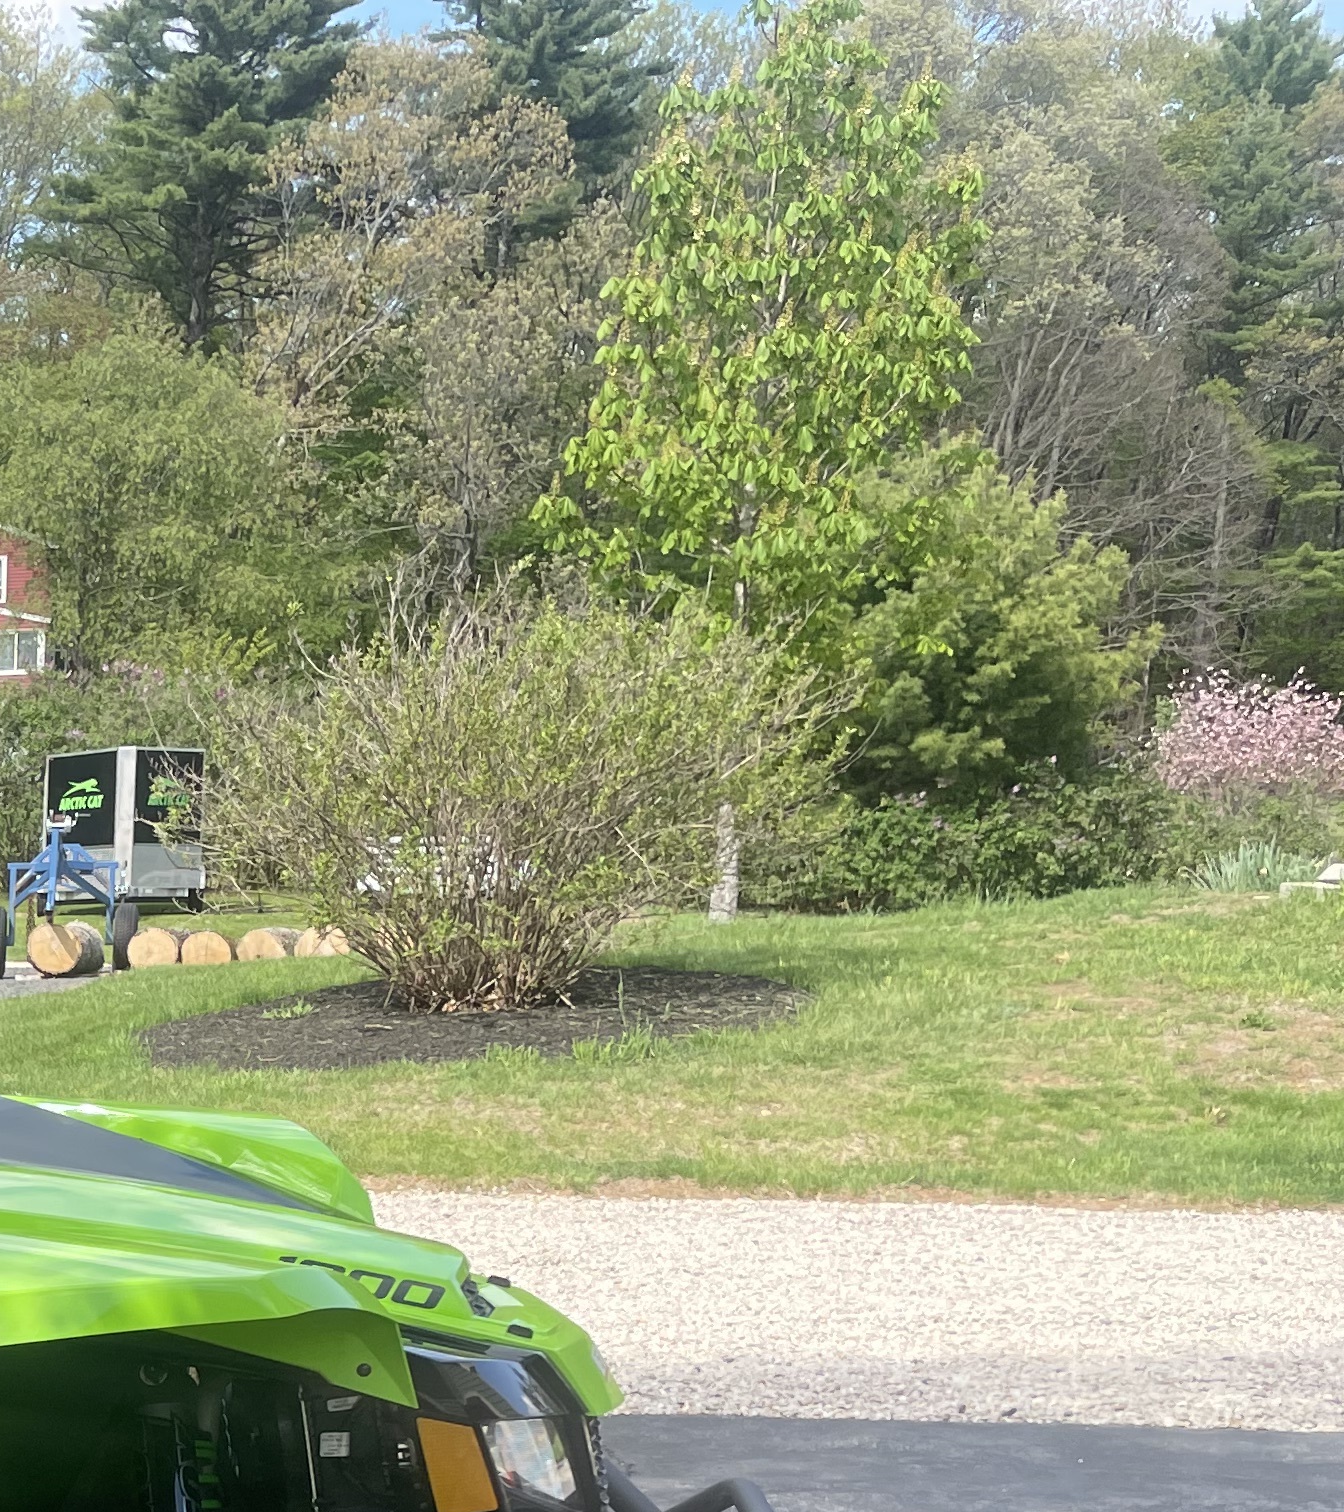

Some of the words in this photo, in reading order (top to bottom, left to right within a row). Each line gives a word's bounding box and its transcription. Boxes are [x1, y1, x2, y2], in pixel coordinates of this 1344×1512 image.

[58, 796, 87, 811] ARCTIC
[87, 794, 104, 809] CAT
[279, 1256, 445, 1310] 00
